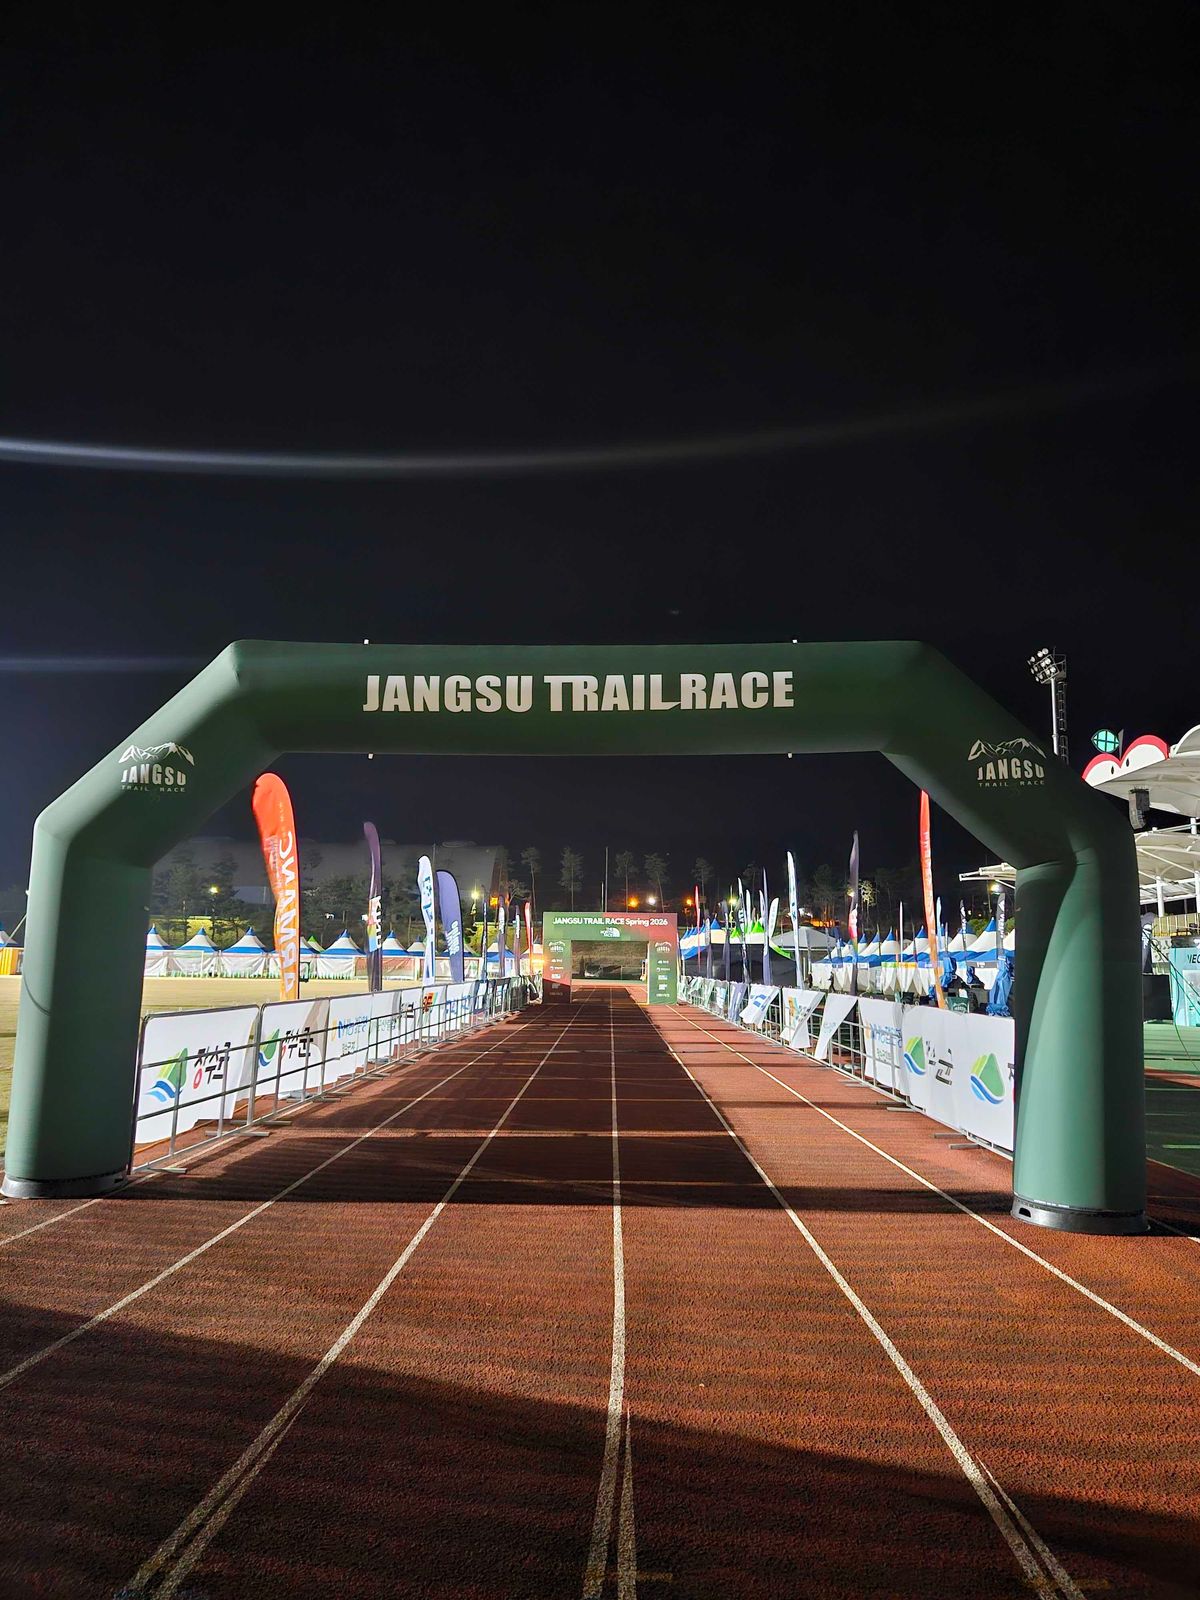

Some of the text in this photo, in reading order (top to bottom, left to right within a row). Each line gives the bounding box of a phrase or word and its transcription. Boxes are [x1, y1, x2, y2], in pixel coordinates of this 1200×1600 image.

[363, 671, 795, 713] JANGSU TRAIL RACE
[120, 763, 187, 786] JANGSU
[977, 757, 1045, 781] JANGSU
[553, 917, 668, 927] JANGSU TRAIL RACE Spring 2026
